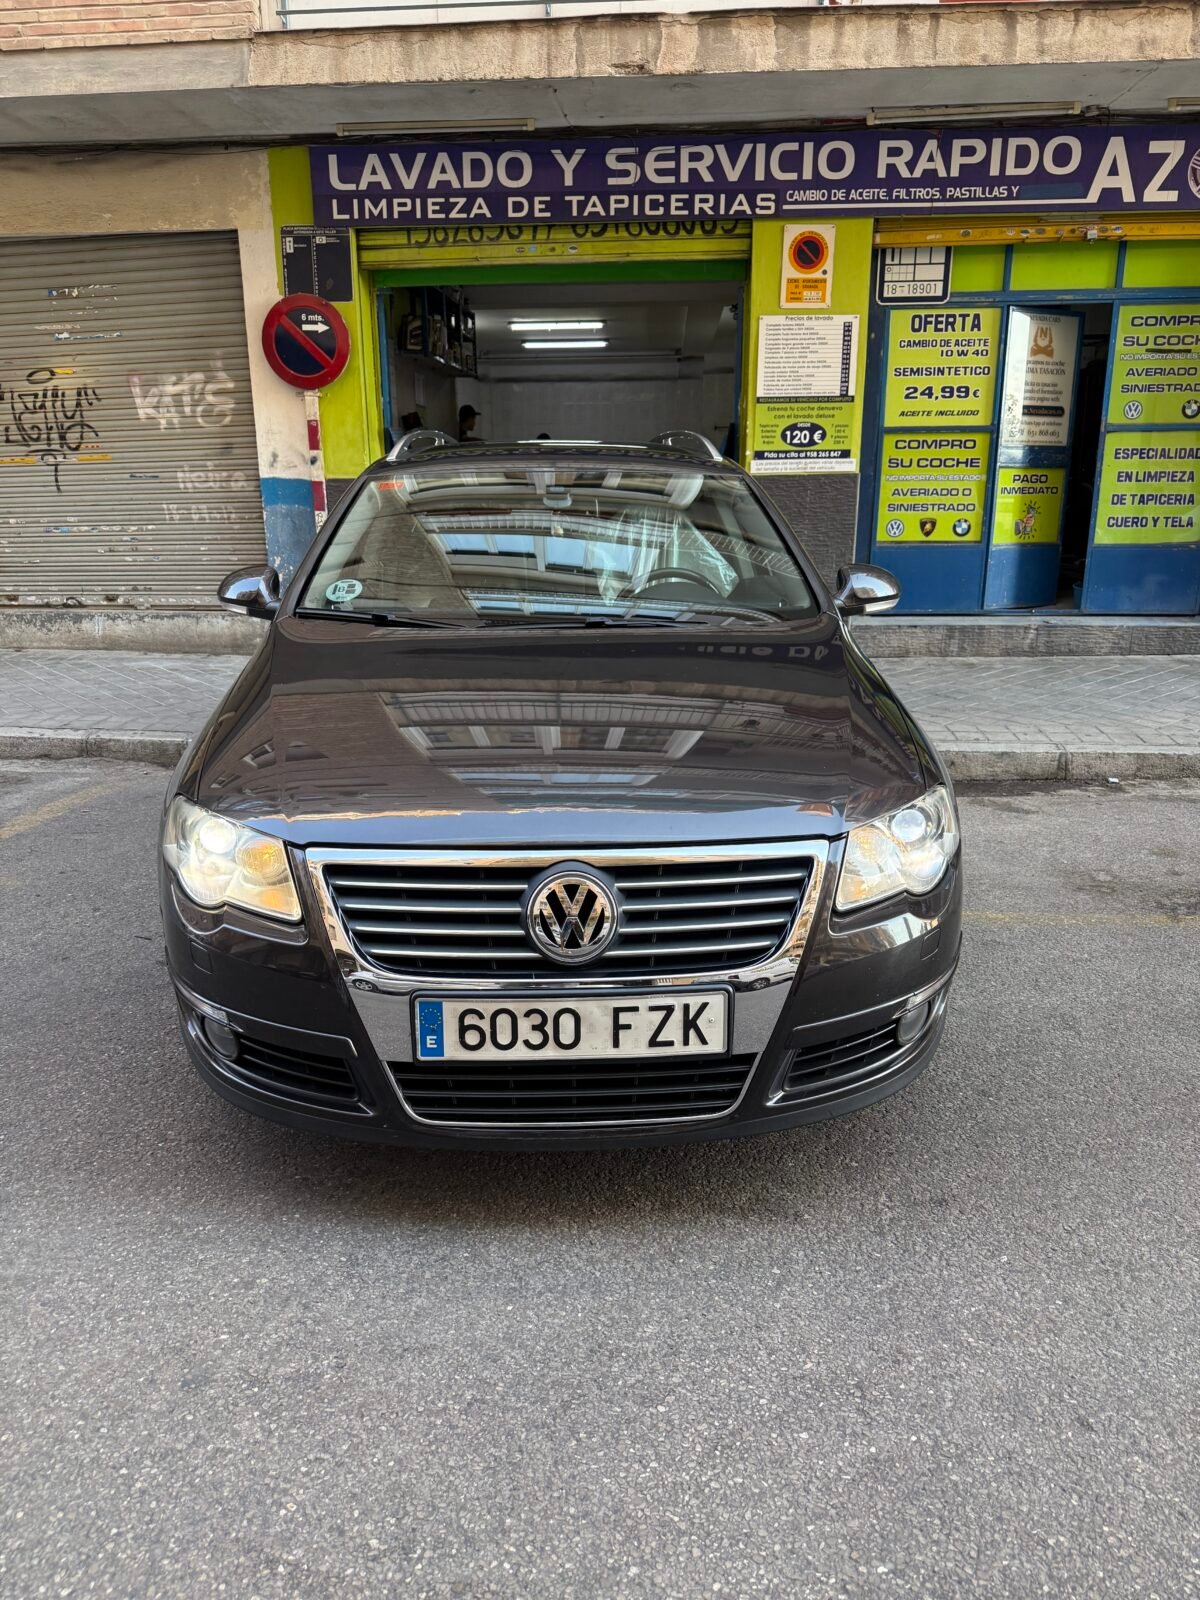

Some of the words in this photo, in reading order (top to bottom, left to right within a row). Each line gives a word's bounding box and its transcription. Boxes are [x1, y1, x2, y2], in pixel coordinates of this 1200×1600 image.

[327, 150, 534, 192] LAVADO
[550, 148, 585, 187] Y
[605, 140, 856, 186] SERVICIO
[876, 134, 1083, 179] RAPIDO
[786, 190, 828, 202] CAMBIO
[831, 189, 846, 201] DE
[849, 188, 887, 202] ACEITE,
[892, 186, 943, 201] FILTROS,
[946, 186, 1006, 199] PASTILLAS
[1007, 186, 1020, 197] Y
[331, 195, 493, 221] LIMPIEZA
[506, 195, 552, 219] DE
[559, 192, 777, 218] TAPICERIAS
[301, 313, 306, 321] 6
[308, 313, 324, 321] mts.
[911, 313, 981, 333] OFERTA
[899, 339, 938, 348] CAMBIO
[940, 339, 952, 348] DE
[954, 338, 989, 348] ACEITE
[1123, 336, 1149, 347] SU
[956, 349, 969, 357] W
[971, 349, 989, 357] 40
[894, 366, 991, 377] SEMISINTETICO
[1126, 367, 1198, 377] AVERIADO
[904, 385, 970, 401] 24,99
[973, 389, 980, 398] €
[934, 409, 980, 417] INCLUIDO
[785, 431, 810, 444] 120
[813, 430, 823, 443] €
[894, 439, 977, 450] COMPRO
[888, 457, 913, 468] SU
[917, 457, 981, 468] COCHE
[1012, 474, 1049, 484] PAGO
[1117, 471, 1133, 483] EN
[1135, 471, 1195, 483] LIMPIEZA
[891, 488, 960, 497] AVERIADO
[961, 488, 972, 497] O
[1000, 486, 1059, 495] INMEDIATO
[1111, 494, 1127, 505] DE
[1130, 494, 1195, 505] TAPICERIA
[887, 503, 976, 512] SINIESTRADO
[1107, 516, 1148, 528] CUERO
[1152, 516, 1160, 527] Y
[1163, 516, 1194, 527] TELA
[426, 1036, 438, 1048] E
[458, 1007, 582, 1052] 6030
[612, 1001, 710, 1049] FZK
